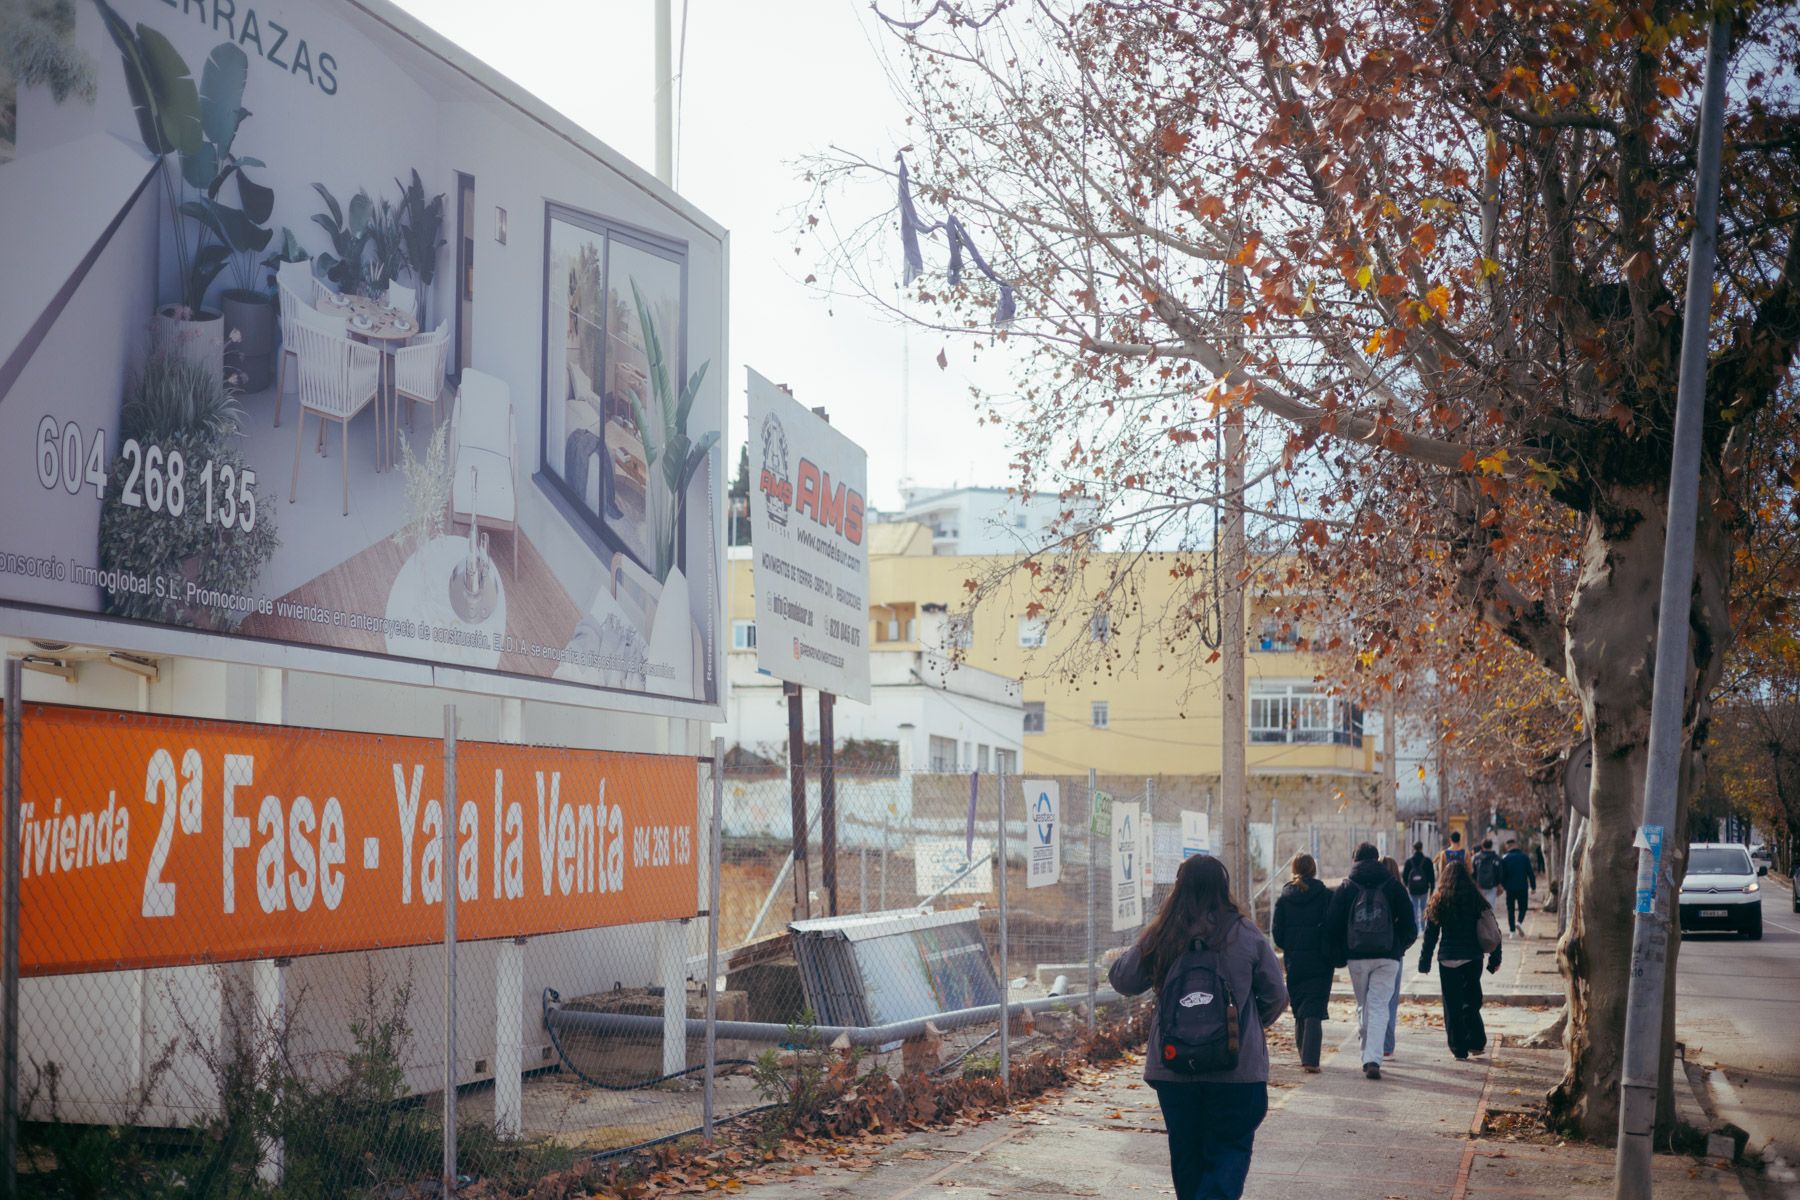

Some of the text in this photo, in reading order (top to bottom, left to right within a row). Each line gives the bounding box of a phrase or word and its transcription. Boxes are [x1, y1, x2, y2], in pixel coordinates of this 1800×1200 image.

[160, 0, 339, 96] RAZAS
[36, 415, 256, 533] 604 268 135
[760, 468, 793, 507] AMS
[796, 457, 865, 546] AMS
[70, 558, 150, 594] Inmoglobal
[155, 576, 181, 600] S.L.
[186, 582, 254, 612] Promocion
[258, 595, 273, 615] de
[277, 598, 330, 624] viviendas
[333, 611, 347, 627] en
[350, 611, 416, 639] anteproyecto
[417, 620, 431, 640] de
[531, 644, 541, 657] se
[222, 754, 346, 914] Fase
[392, 763, 443, 905] Ya
[457, 800, 478, 902] a
[493, 768, 524, 900] la
[535, 771, 624, 896] Venta
[633, 825, 650, 868] 604
[652, 825, 670, 867] 268
[672, 825, 691, 866] 135
